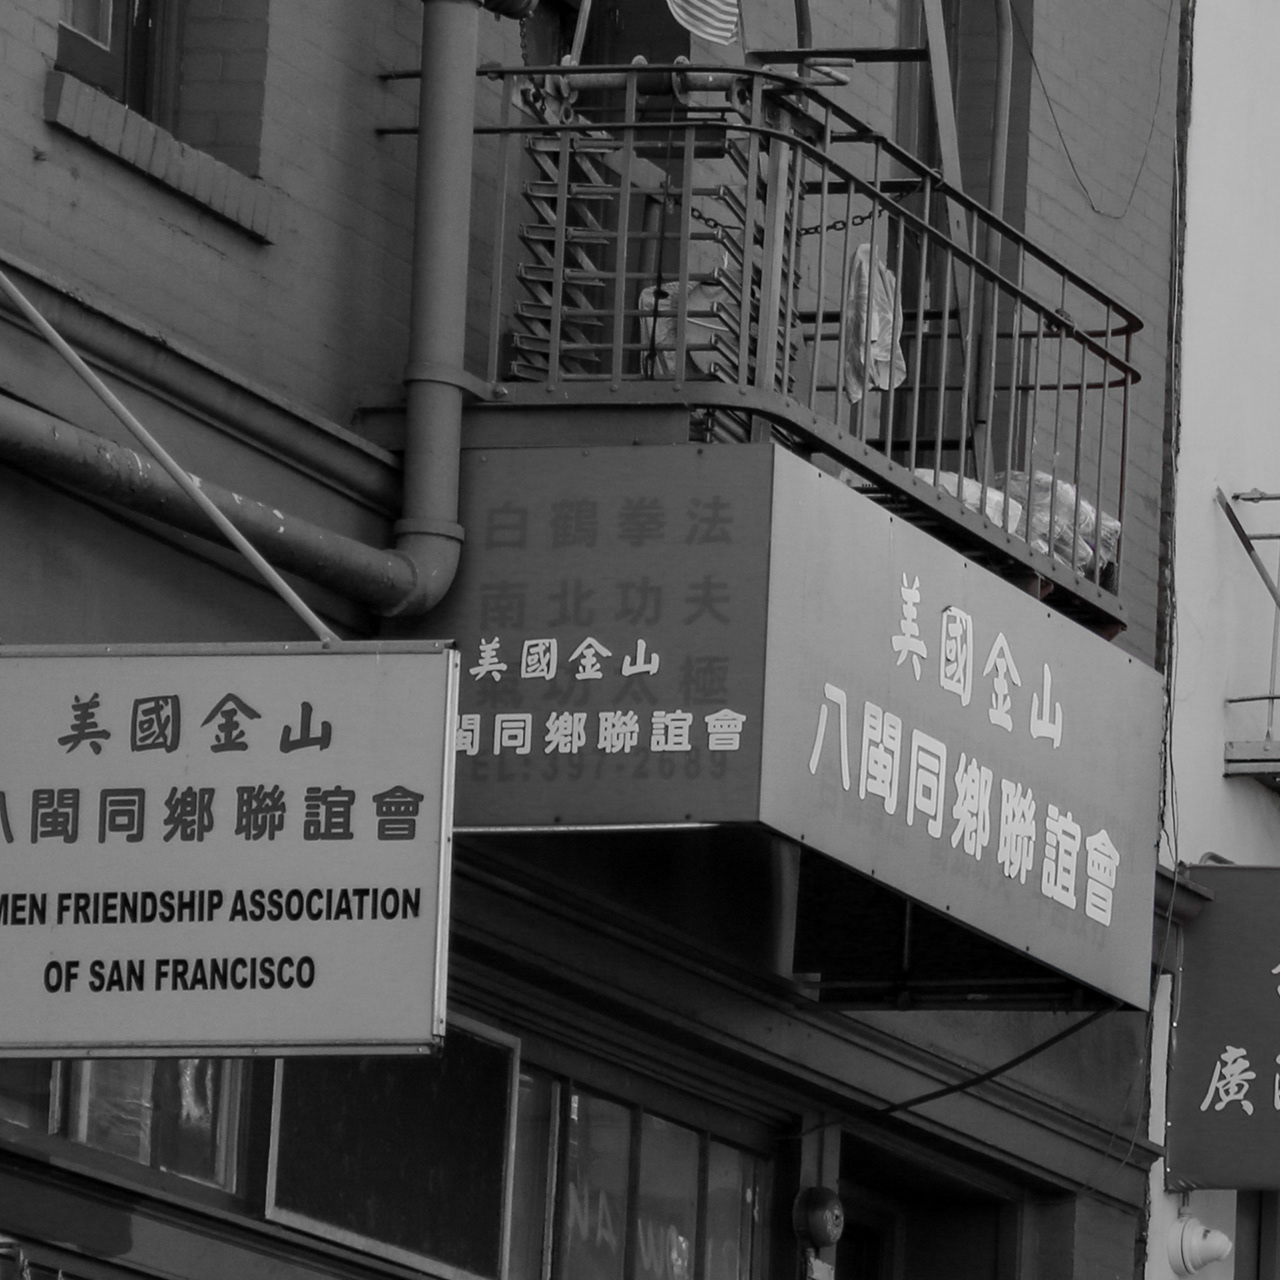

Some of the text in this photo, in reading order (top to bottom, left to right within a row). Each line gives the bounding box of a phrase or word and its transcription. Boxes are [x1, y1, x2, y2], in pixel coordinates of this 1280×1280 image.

[469, 636, 660, 682] 美國金山
[892, 572, 1063, 749] 美國金山
[58, 693, 332, 755] 美國金山
[809, 683, 1120, 927] 八閩同鄉聯誼會
[57, 890, 223, 925] FRIENDSHIP
[229, 888, 421, 922] ASSOCIATION
[43, 955, 316, 993] OF SAN FRANCISCO
